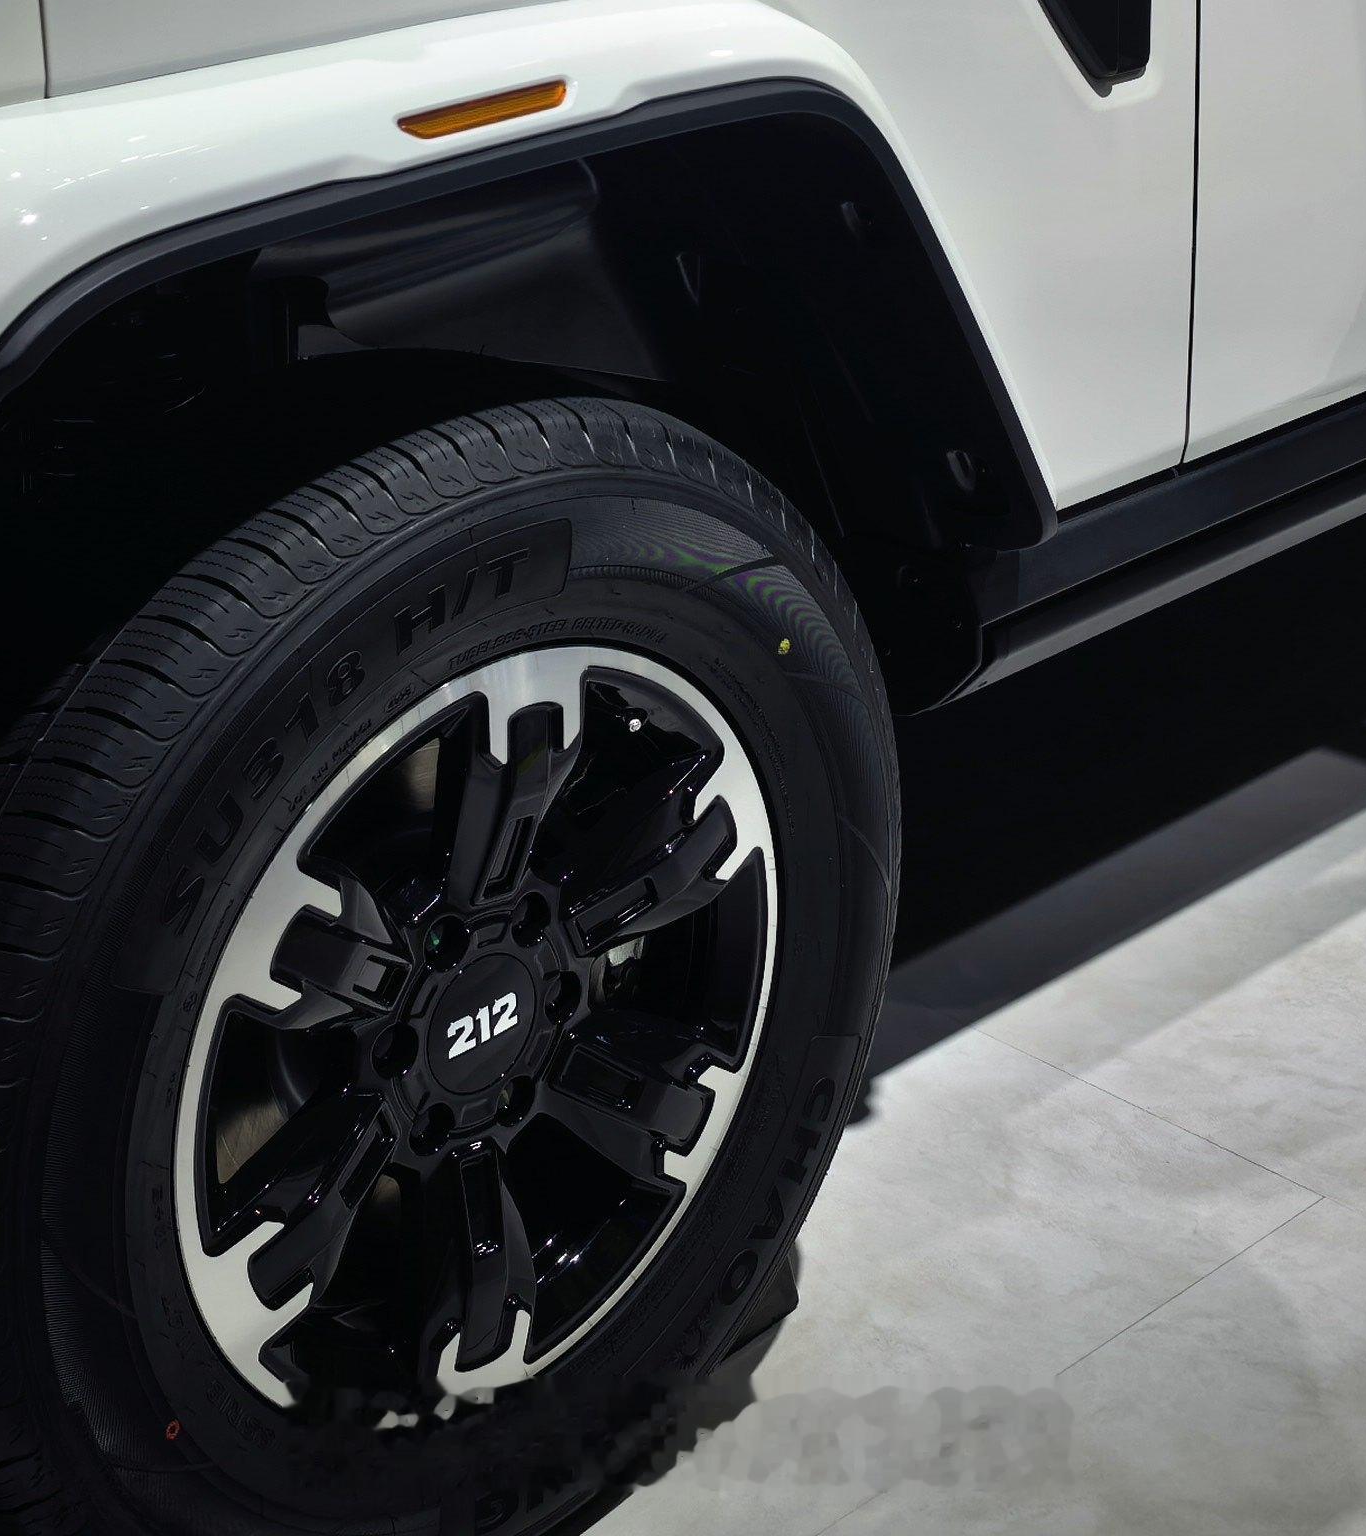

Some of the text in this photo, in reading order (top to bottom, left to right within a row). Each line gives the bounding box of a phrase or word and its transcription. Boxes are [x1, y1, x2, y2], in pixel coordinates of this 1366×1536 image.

[162, 649, 365, 937] SU318
[394, 547, 531, 655] H/T
[447, 992, 520, 1059] 212
